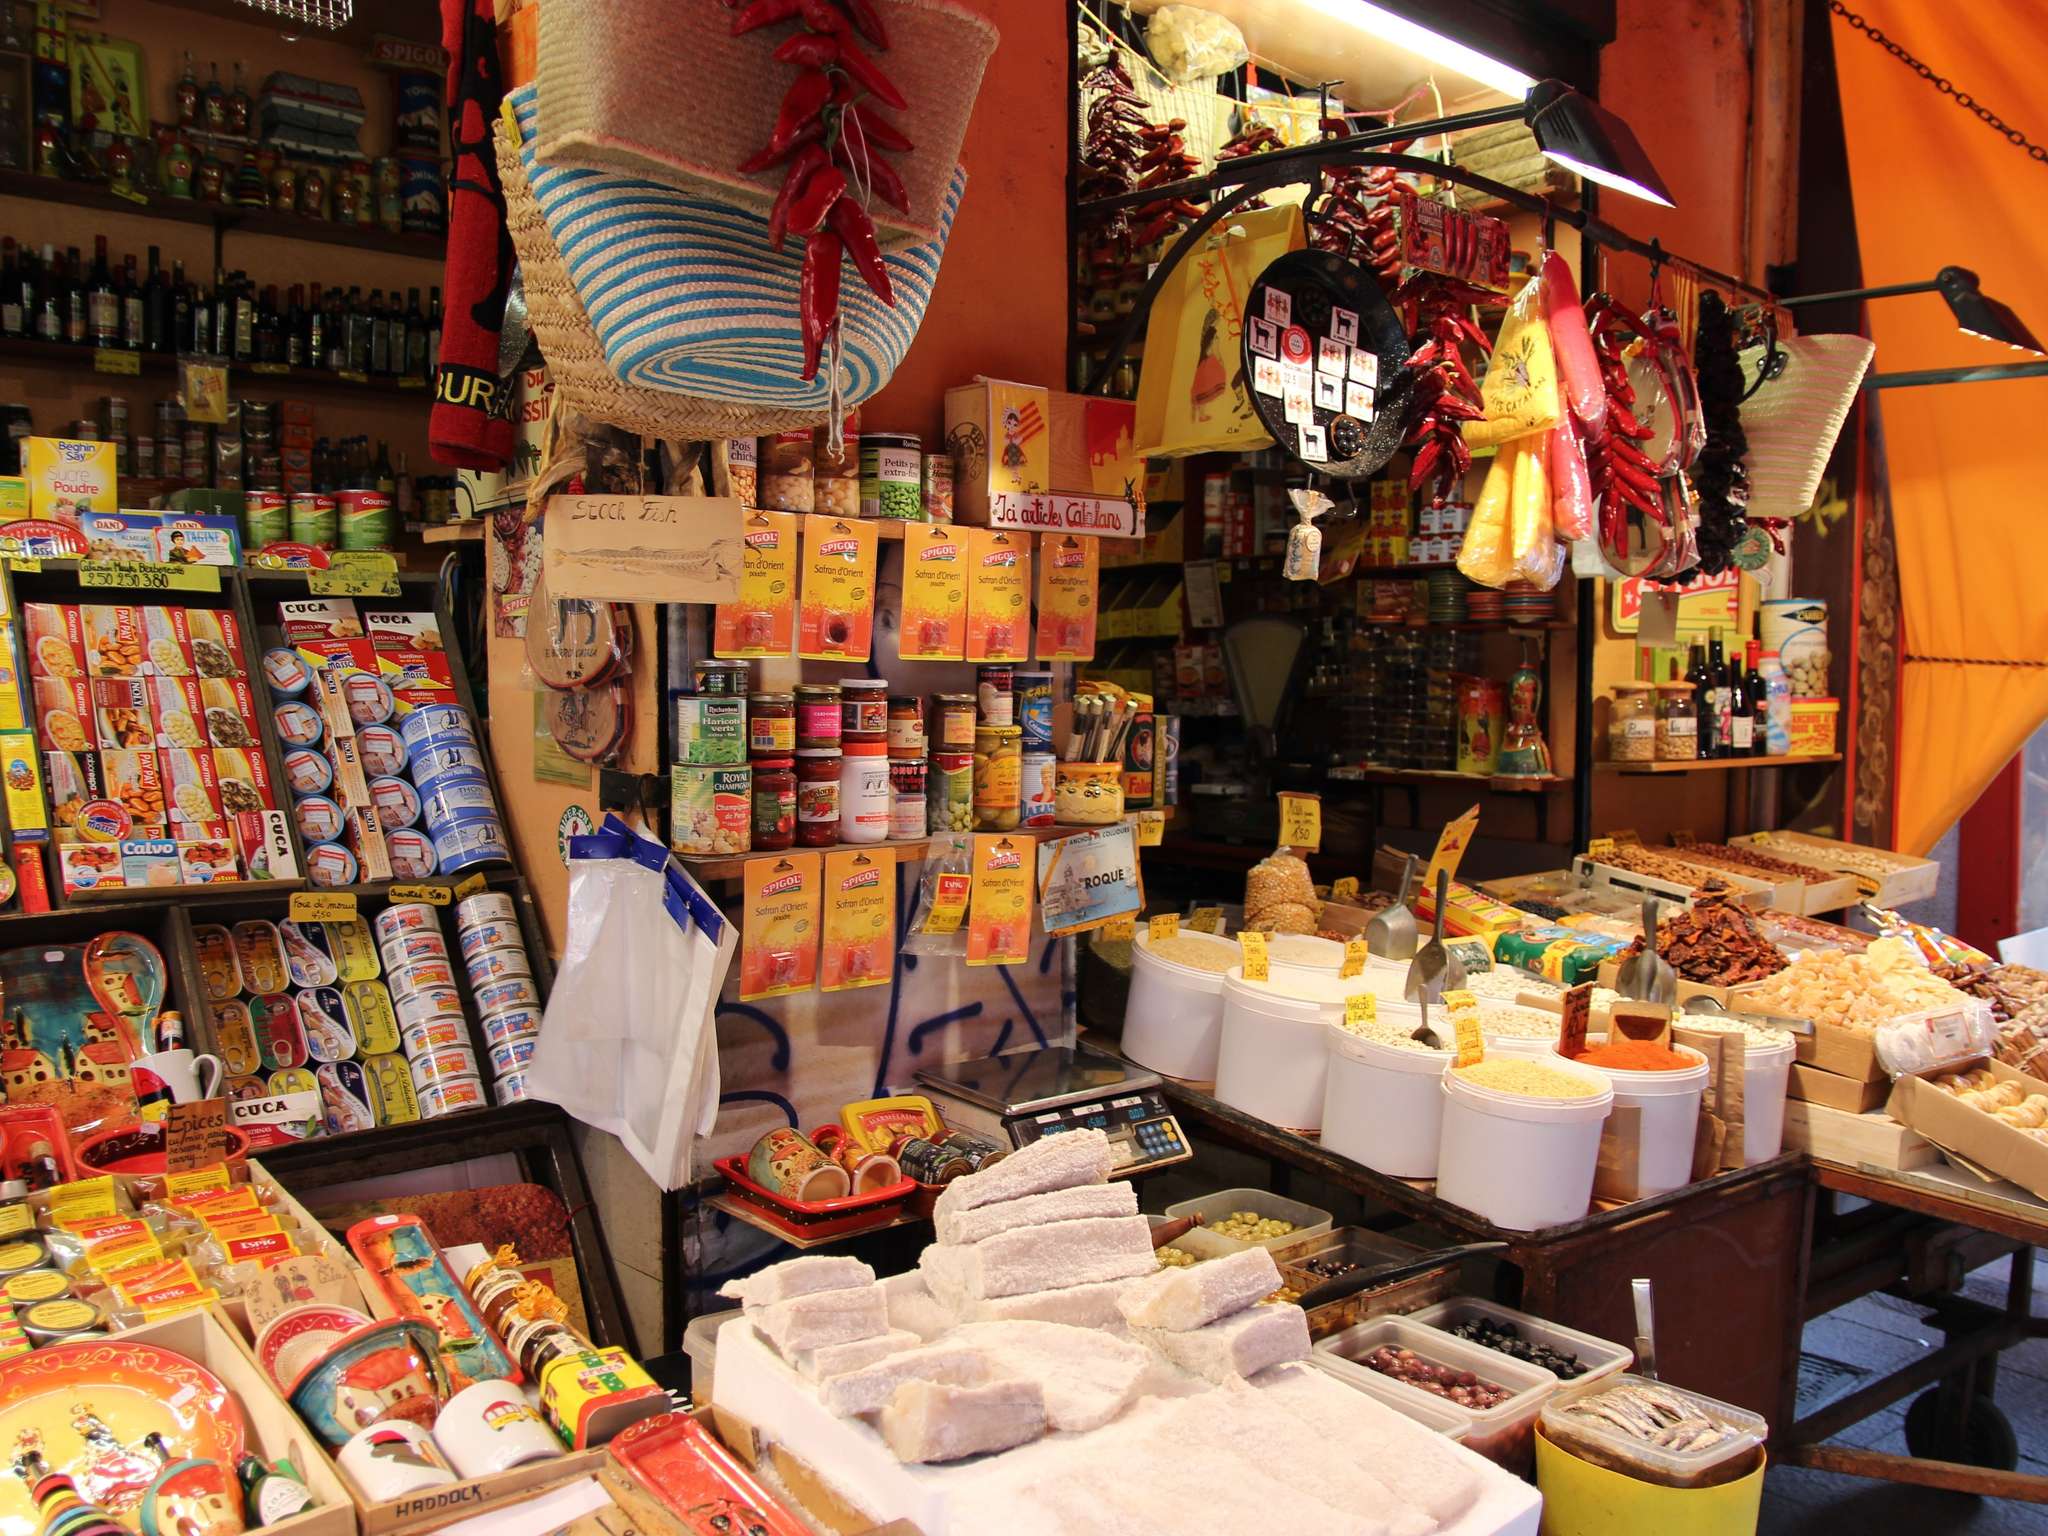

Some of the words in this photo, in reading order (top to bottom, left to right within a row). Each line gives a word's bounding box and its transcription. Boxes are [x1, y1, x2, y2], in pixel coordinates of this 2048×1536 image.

[58, 441, 96, 454] Beghin
[731, 439, 752, 450] Pois
[66, 452, 85, 464] Say
[884, 458, 909, 468] Petits
[54, 481, 99, 495] Poudre
[571, 500, 626, 521] Stock
[1020, 500, 1063, 528] articles
[96, 520, 121, 530] DANI
[821, 541, 859, 556] SPIGOL
[920, 545, 957, 561] SPIGOL
[982, 550, 1019, 566] SPIGOL
[814, 564, 838, 575] Safran
[915, 569, 935, 580] Safran
[978, 575, 997, 584] Safran
[285, 602, 329, 613] CUCA
[118, 609, 131, 624] PAY
[369, 614, 412, 624] CUCA
[67, 610, 80, 644] Gourmet
[119, 624, 133, 641] PAY
[174, 611, 186, 643] Gourmet
[223, 614, 236, 649] Gourmet
[76, 682, 89, 717] Gourmet
[131, 682, 145, 708] NOLY
[186, 682, 199, 714] Gourmet
[236, 682, 250, 717] Gourmet
[703, 717, 741, 728] Haricots
[711, 727, 735, 735] verts
[344, 741, 355, 763] NOLY
[139, 753, 152, 771] PAY
[251, 751, 266, 788] Gourmet
[200, 753, 214, 788] Gourmet
[723, 772, 748, 784] ROYAL
[142, 771, 156, 791] PAY
[366, 810, 376, 833] NOLY
[270, 812, 288, 857] CUCA
[986, 854, 1020, 869] SPIGOL
[761, 874, 802, 898] SPIGOL
[841, 870, 879, 891] SPIGOL
[1084, 868, 1125, 890] ROQUE
[235, 1100, 289, 1118] CUCA
[95, 1224, 132, 1236] ESPIG
[239, 1239, 276, 1250] ESPIG
[146, 1288, 186, 1303] ESPIG
